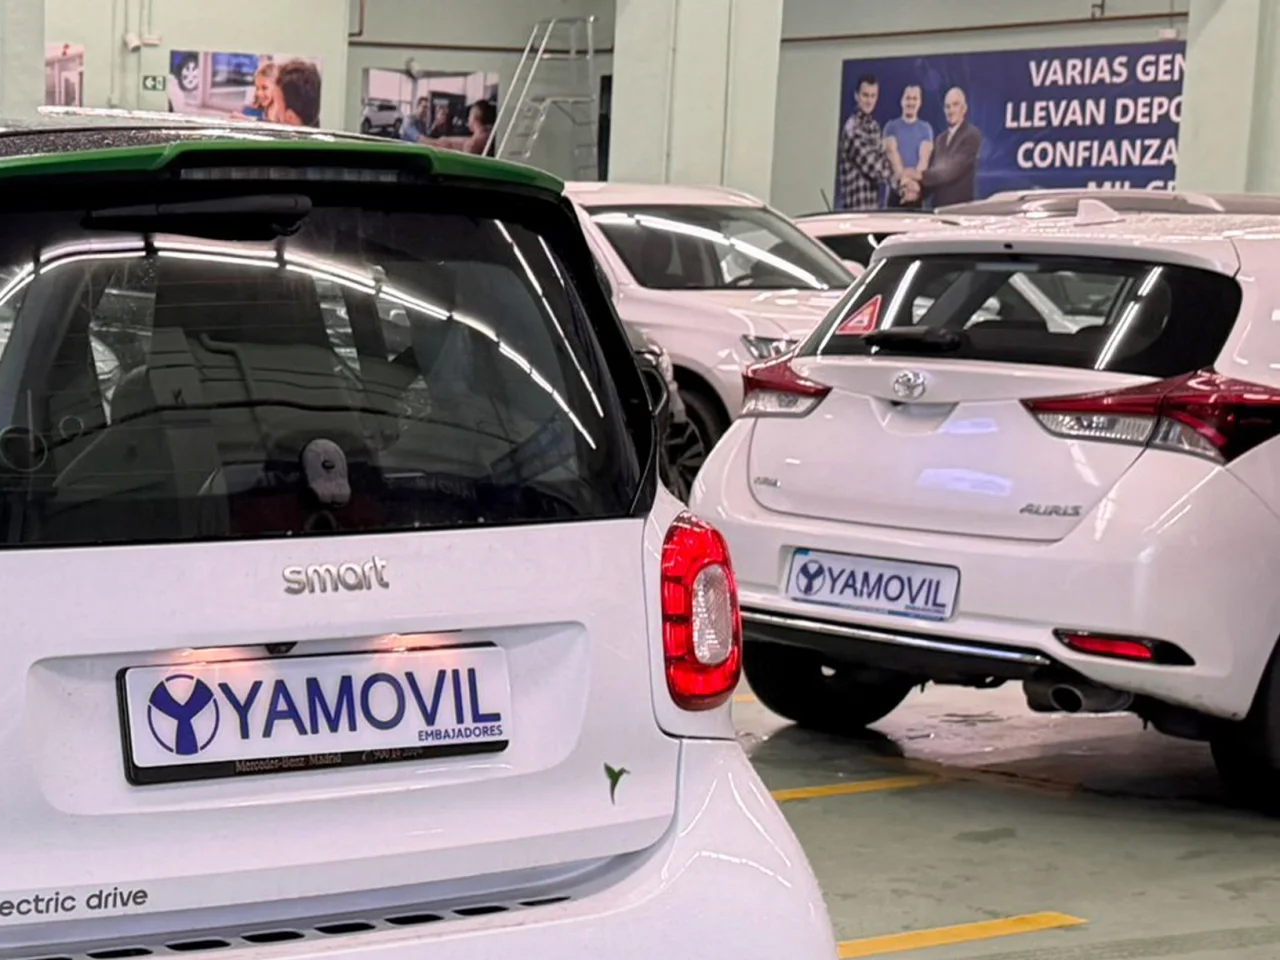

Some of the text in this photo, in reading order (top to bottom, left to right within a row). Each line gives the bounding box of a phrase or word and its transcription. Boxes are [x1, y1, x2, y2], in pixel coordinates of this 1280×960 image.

[1029, 55, 1129, 87] VARIAS
[1005, 98, 1106, 128] LLEVAN
[1016, 138, 1179, 168] CONFIANZA
[1019, 503, 1083, 517] AURIS
[282, 555, 389, 595] smart
[827, 566, 947, 608] YAMOVIL
[219, 667, 501, 739] YAMOVIL
[418, 725, 503, 741] EMBAJADORES
[308, 753, 342, 766] Madrid
[86, 887, 148, 910] drive
